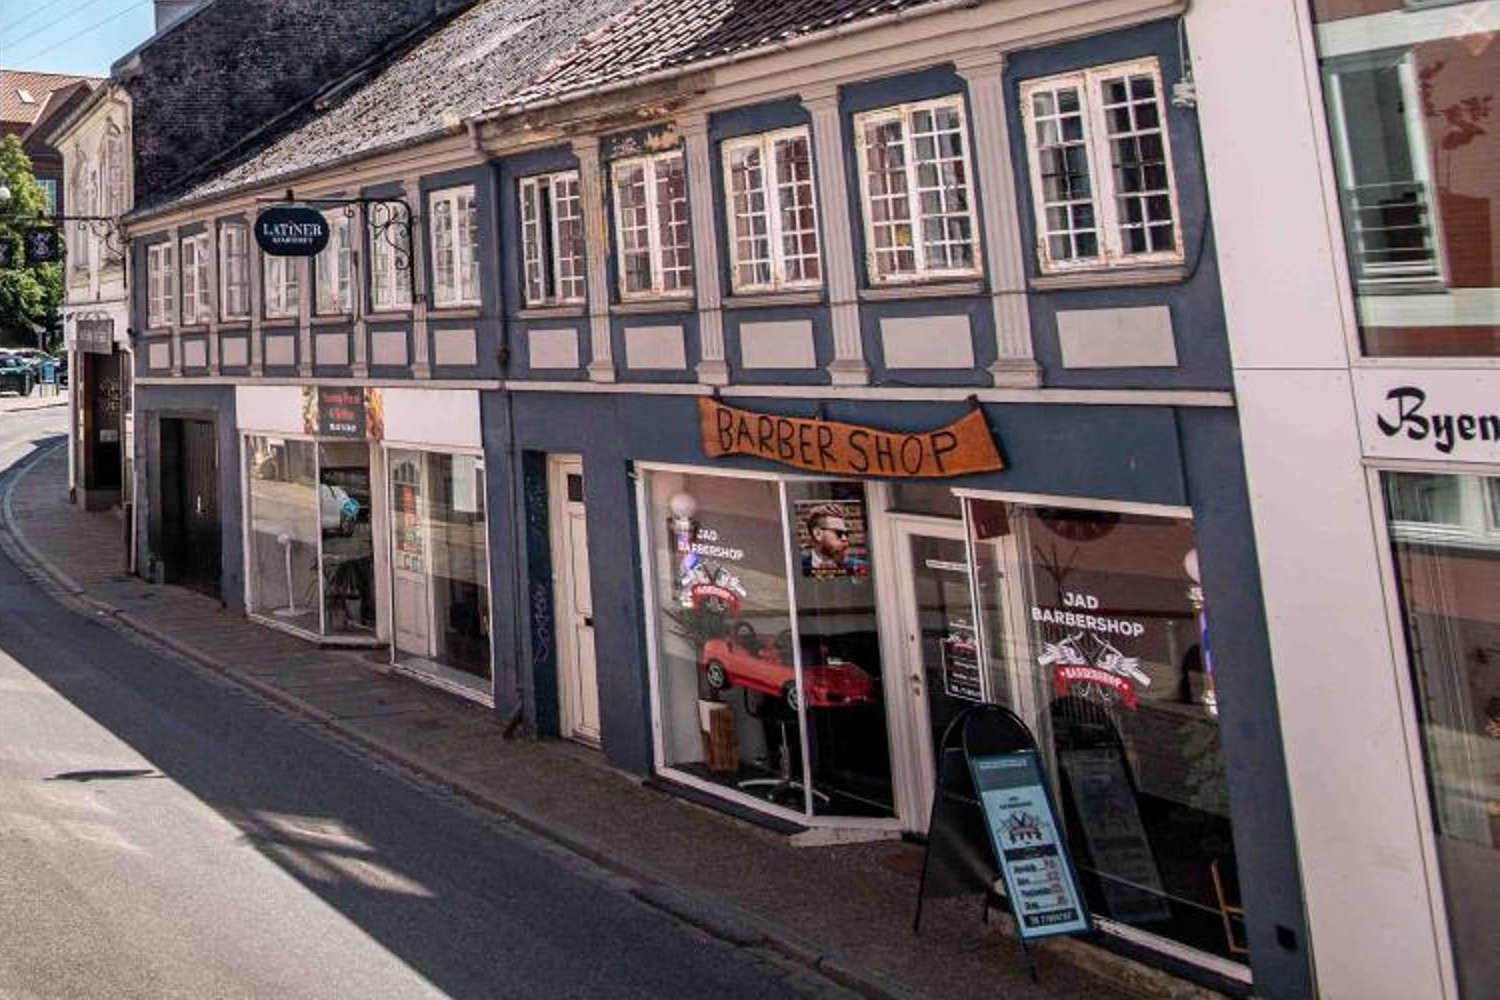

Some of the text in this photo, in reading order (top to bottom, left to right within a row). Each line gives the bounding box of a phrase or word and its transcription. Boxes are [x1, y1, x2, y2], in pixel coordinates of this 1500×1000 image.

[717, 408, 958, 475] BARBER SHOP
[1377, 386, 1500, 454] Byen
[1031, 607, 1144, 637] BARBERSHOP
[1063, 592, 1099, 609] JAD
